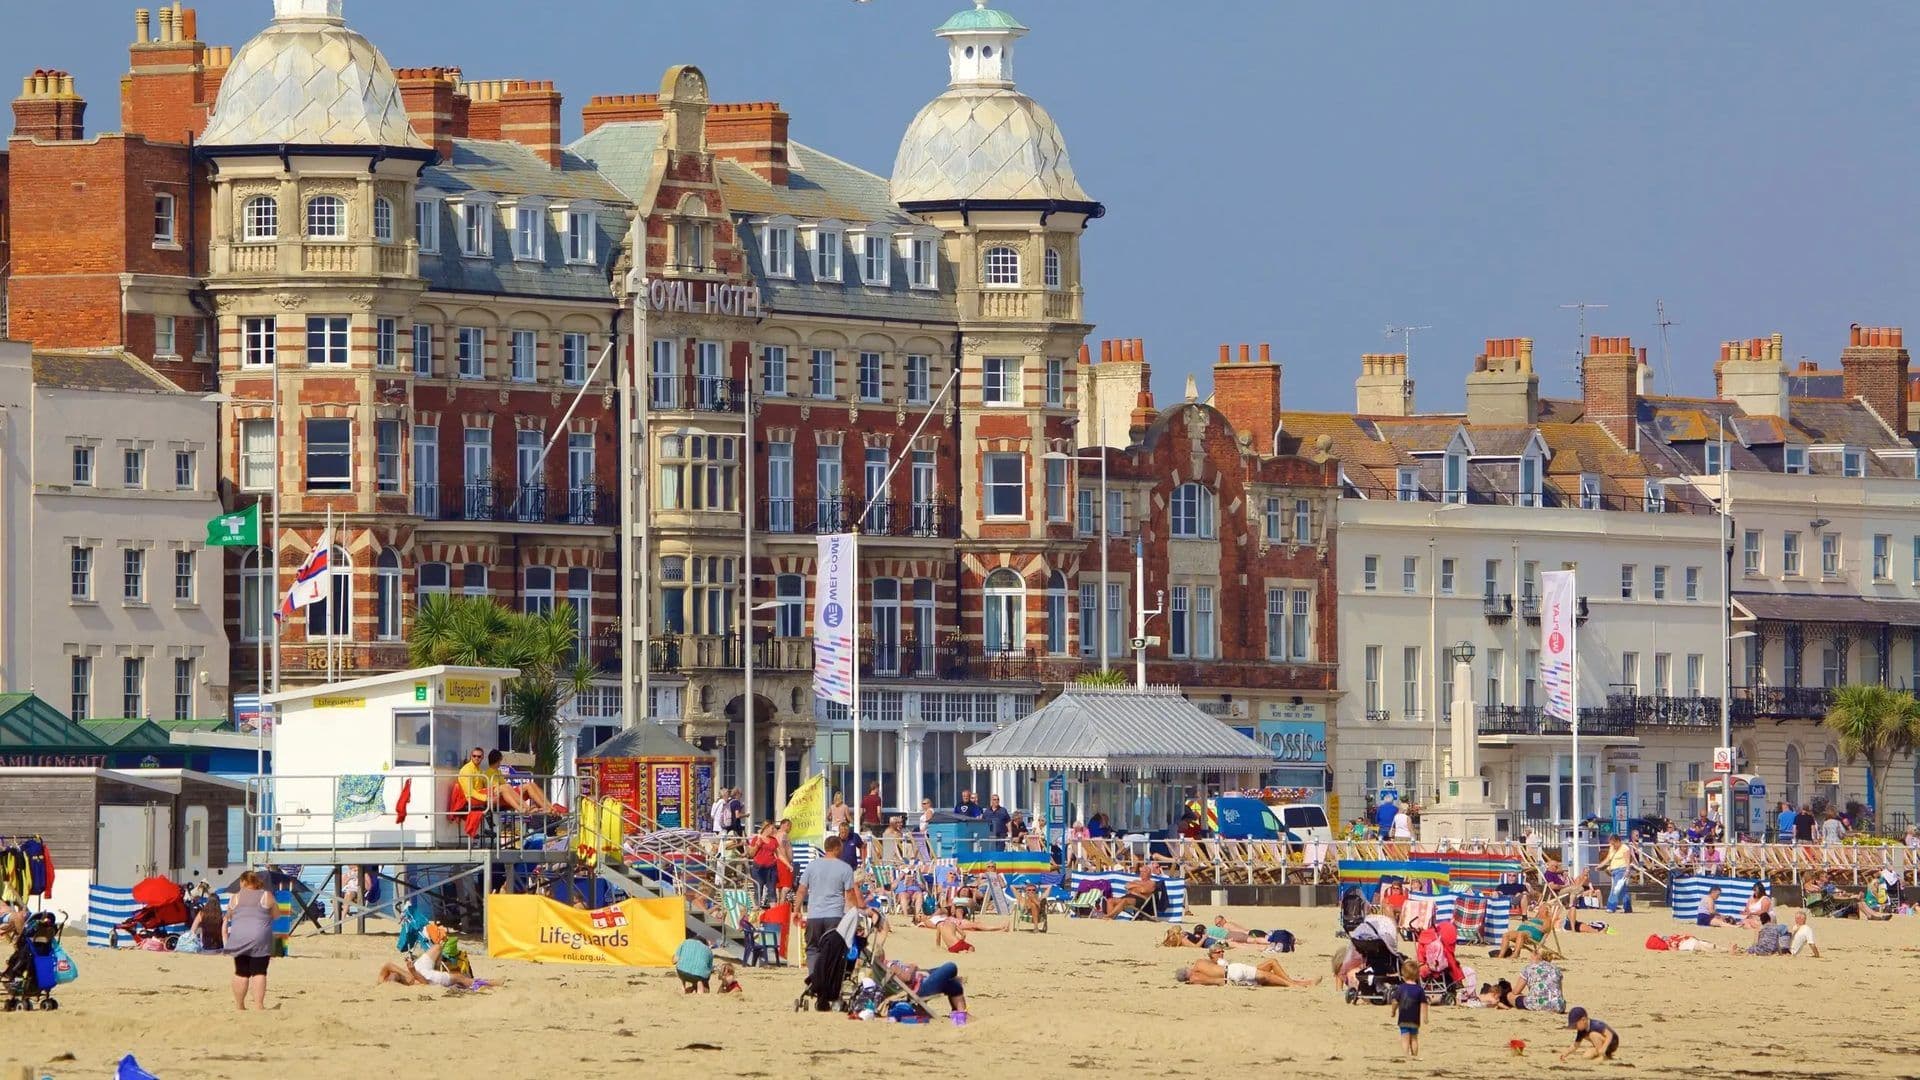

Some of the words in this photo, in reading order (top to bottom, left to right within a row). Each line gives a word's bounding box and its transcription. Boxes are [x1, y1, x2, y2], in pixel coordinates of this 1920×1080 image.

[647, 279, 695, 313] OYAL
[706, 282, 768, 318] HOTEL
[449, 680, 480, 702] Lifeguards
[1385, 764, 1394, 777] P
[540, 927, 629, 950] Lifeguards
[562, 953, 607, 963] rnli.org.uk
